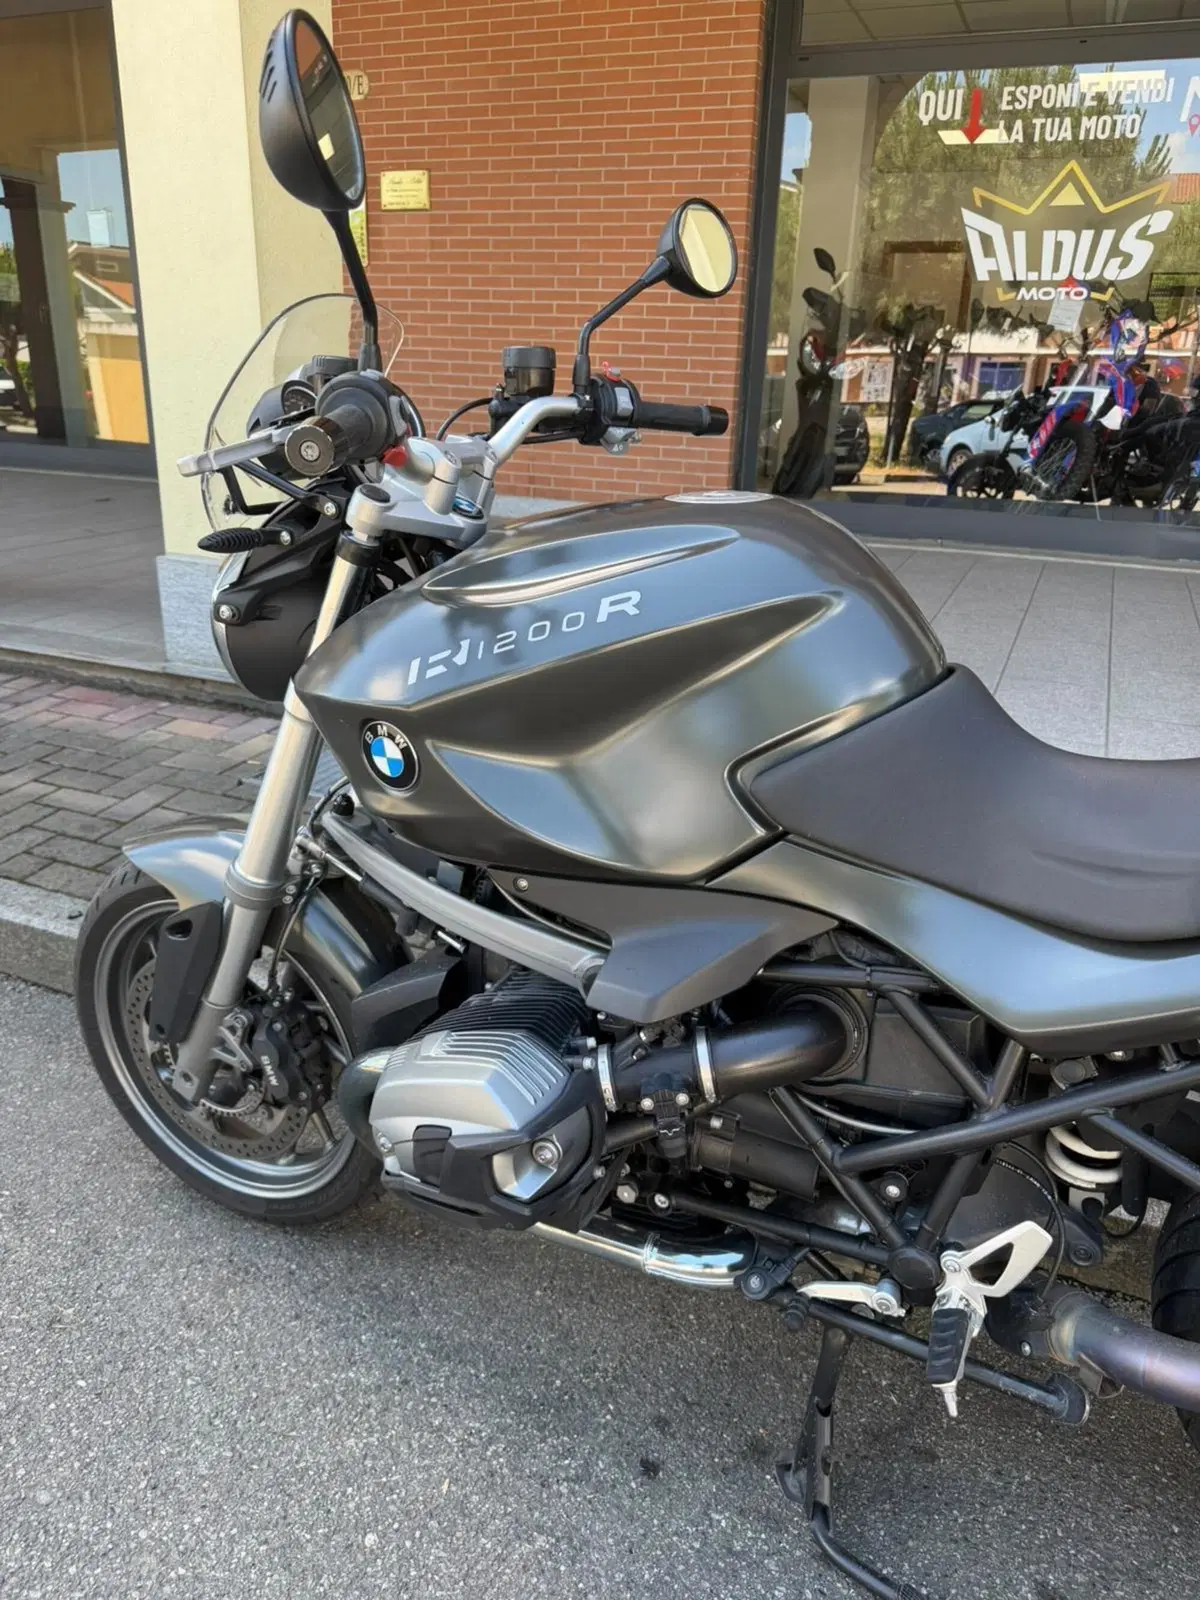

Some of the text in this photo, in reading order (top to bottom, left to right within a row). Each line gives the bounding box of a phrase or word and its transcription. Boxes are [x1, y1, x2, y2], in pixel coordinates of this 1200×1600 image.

[918, 88, 964, 126] QUI
[1000, 83, 1081, 110] ESPONI
[1086, 81, 1101, 107] E
[1103, 77, 1175, 104] VENDI
[998, 114, 1141, 143] LA TUA MOTO
[960, 206, 1174, 282] ALDUS
[1016, 286, 1089, 301] MOTO
[364, 724, 408, 749] BMW
[260, 1055, 280, 1086] BMW
